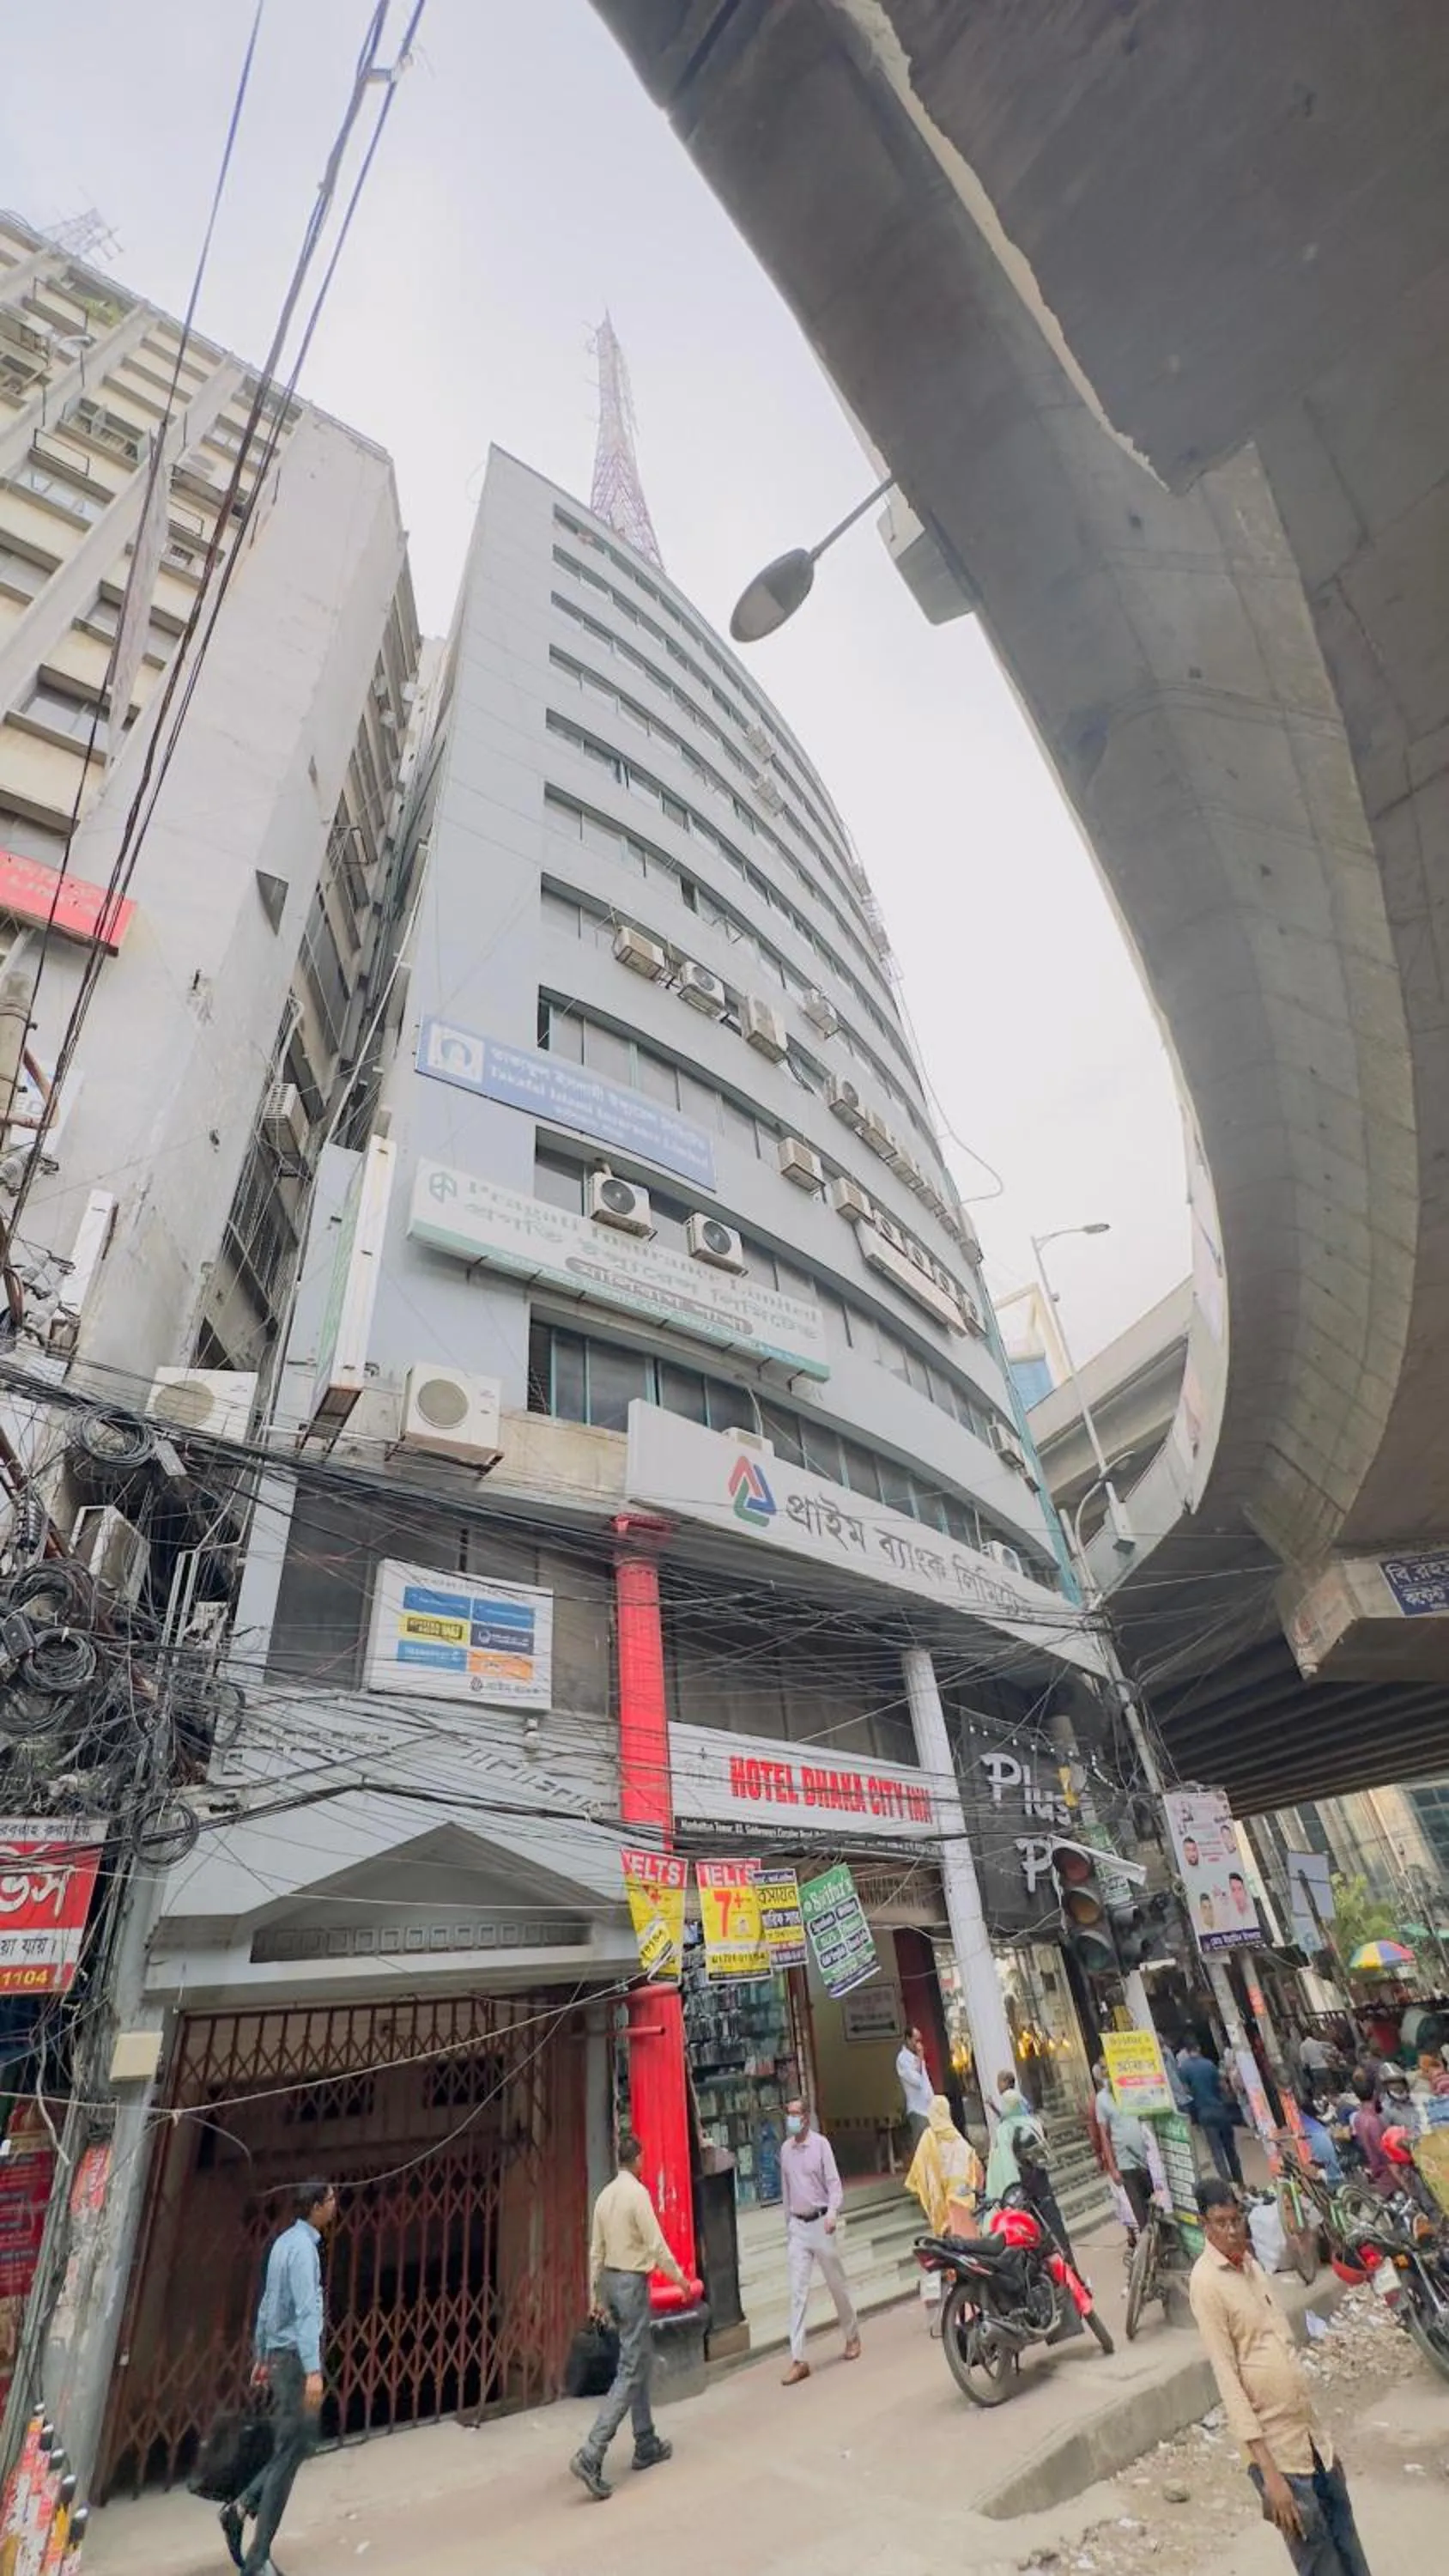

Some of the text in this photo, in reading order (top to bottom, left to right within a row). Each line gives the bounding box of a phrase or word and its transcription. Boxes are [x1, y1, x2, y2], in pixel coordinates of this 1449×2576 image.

[786, 1492, 866, 1552] প্রাইম
[873, 1527, 947, 1584] ব্যাংক
[730, 1754, 933, 1825] HOTEL DHAKA CITY INN
[979, 1753, 1072, 1826] Plus
